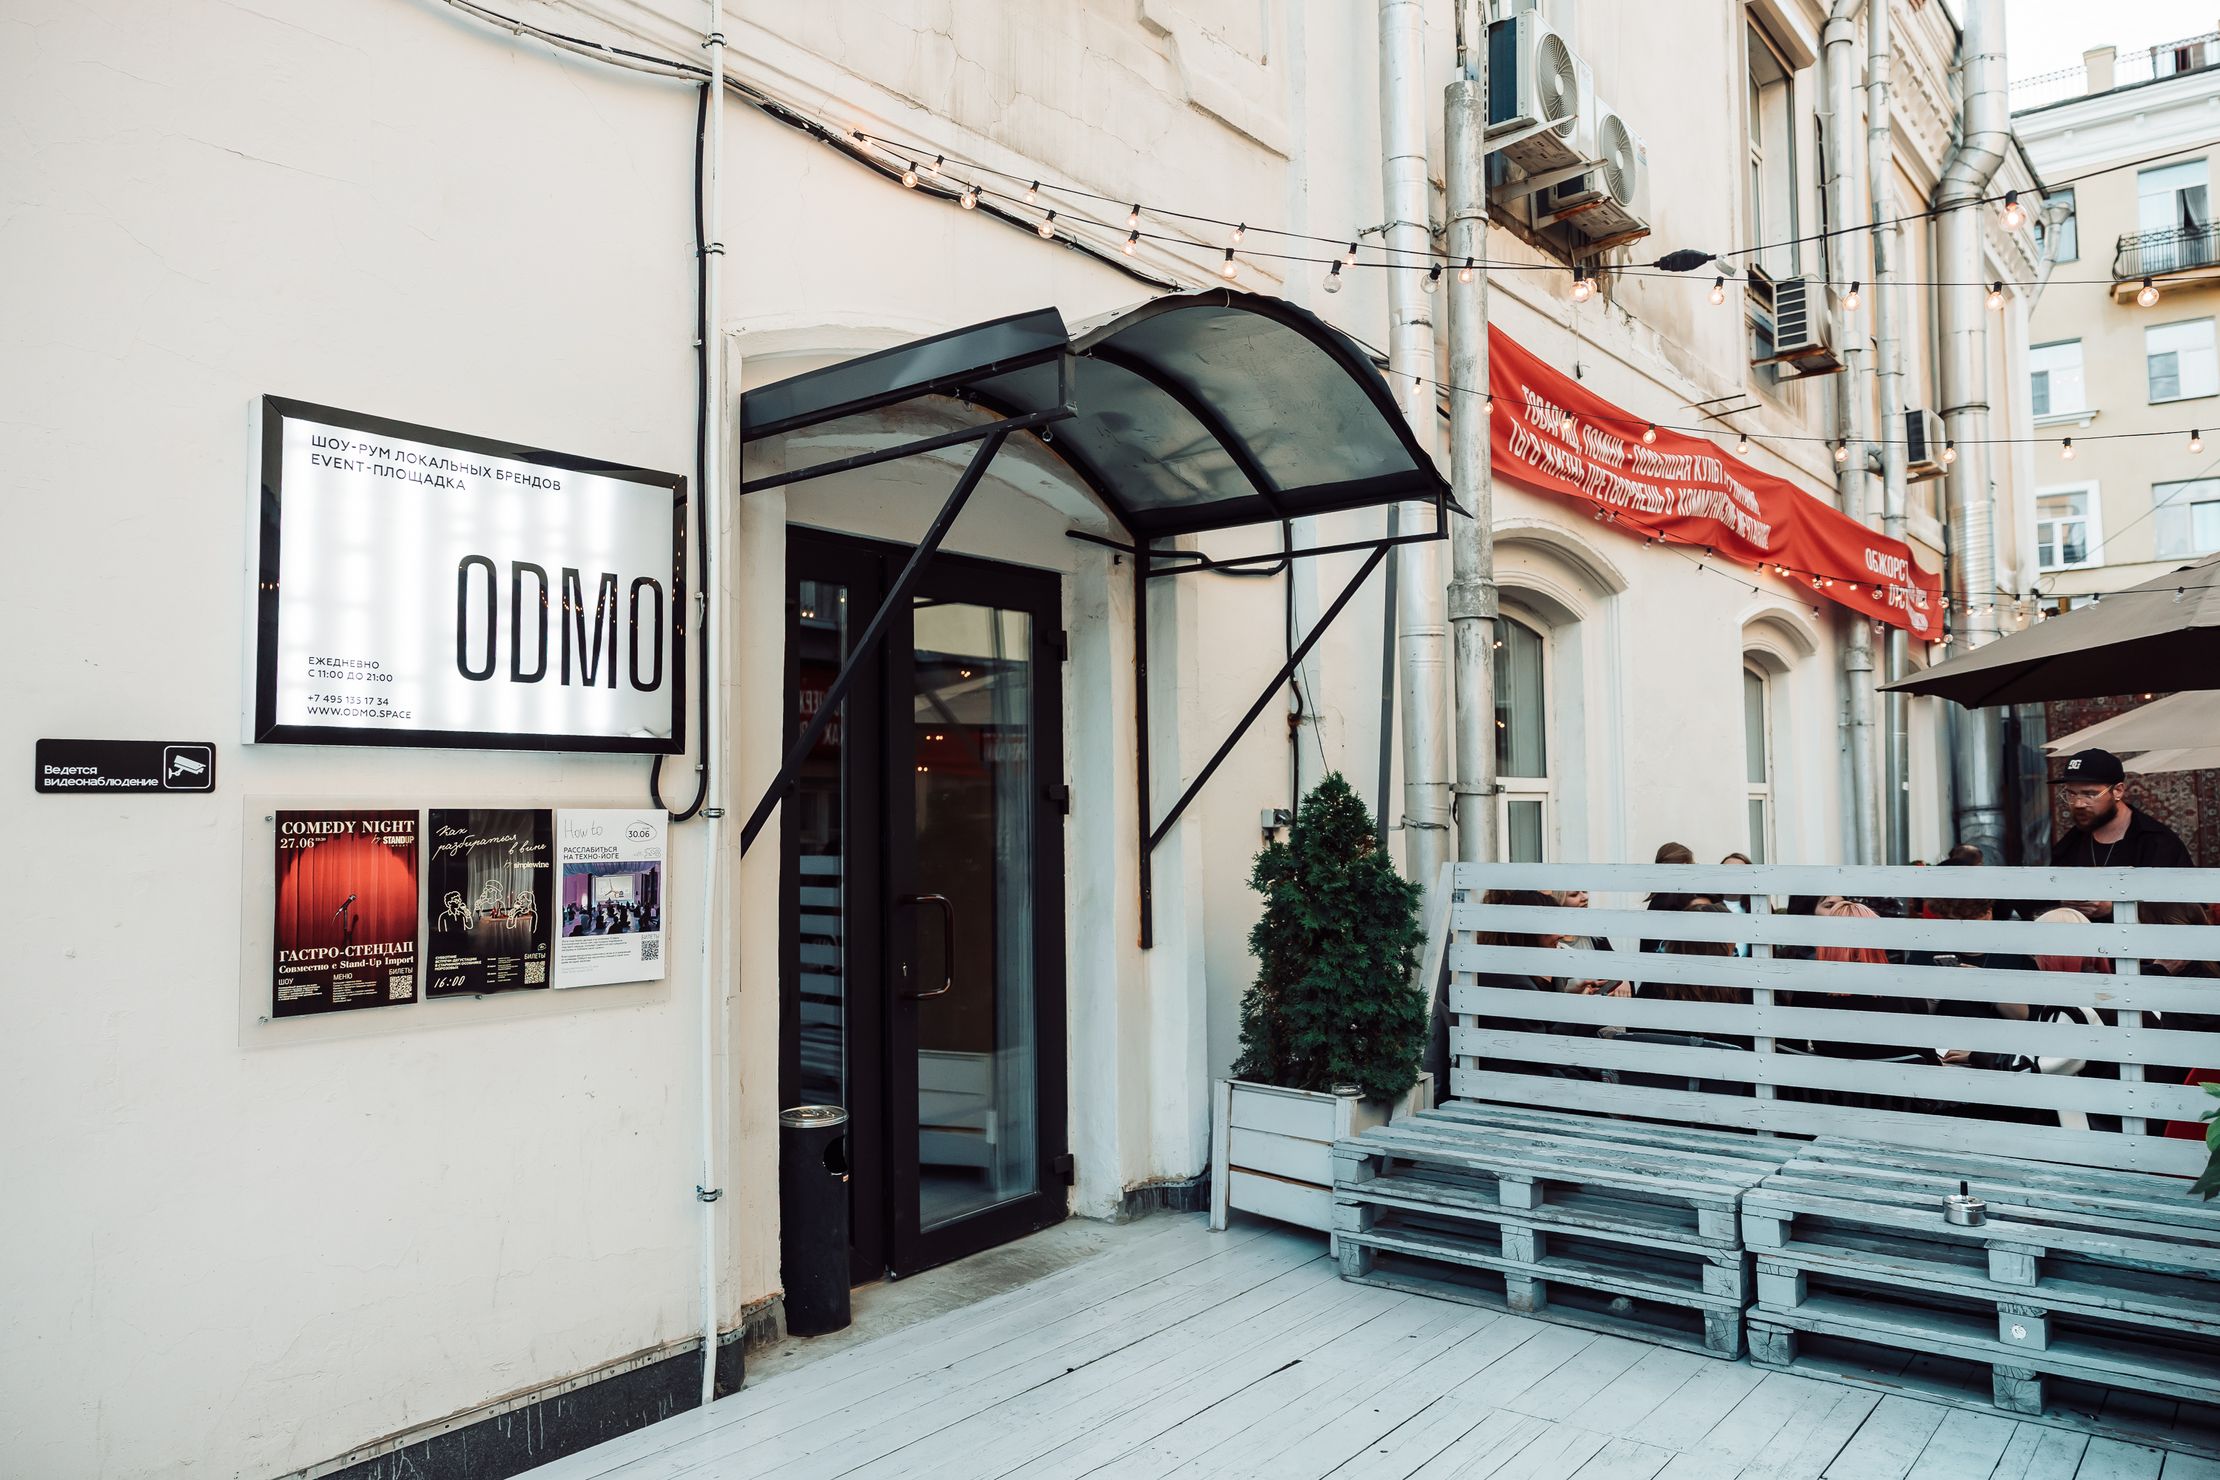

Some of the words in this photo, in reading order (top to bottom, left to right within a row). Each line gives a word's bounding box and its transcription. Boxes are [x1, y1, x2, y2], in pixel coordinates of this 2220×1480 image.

[1582, 424, 1625, 469] ПОМНИ
[1632, 444, 1693, 481] ПОВЫШАЯ
[311, 434, 391, 459] ШОУ-РУМ
[394, 450, 492, 479] ЛОКАЛЬНЫХ
[495, 468, 562, 492] БРЕНДОВ
[1508, 415, 1531, 461] ТЫ
[1528, 431, 1542, 466] В
[1539, 438, 1585, 488] ЖИЗНЬ
[1582, 462, 1665, 514] ПРЕТВОРЯЕШЬ
[1664, 486, 1675, 515] О
[311, 453, 466, 491] EVENT-ПЛОЩАДКА
[456, 554, 664, 692] ODMO
[308, 656, 380, 670] ЕЖЕДНЕВНО
[307, 669, 315, 678] С
[317, 669, 344, 679] 11:00
[346, 671, 364, 681] ДО
[366, 673, 393, 682] 21:00
[307, 694, 320, 703] +7
[322, 694, 343, 704] 495
[345, 696, 362, 705] 135
[364, 697, 374, 705] 17
[376, 697, 389, 706] 34
[307, 706, 412, 719] WWW.ODMO.SPACE
[44, 765, 98, 775] Ведется
[44, 776, 159, 787] видеонаблюдение
[281, 820, 357, 835] COMEDY
[361, 820, 415, 834] NIGHT
[436, 825, 468, 837] Как
[564, 819, 588, 839] How
[591, 819, 604, 836] to
[628, 830, 650, 838] 30.06
[280, 838, 315, 849] 27.06
[431, 834, 517, 861] разбираться
[508, 841, 519, 855] в
[519, 840, 547, 854] вине
[575, 852, 620, 860] ТЕХНО-ЙОГЕ
[279, 941, 414, 962] ГАСТРО-СТЕНДАП
[279, 963, 329, 974] Совместно
[339, 958, 382, 969] Stand-Up
[384, 956, 414, 966] Import
[388, 967, 414, 976] БИЛЕТЫ
[278, 977, 294, 986] ШОУ
[333, 973, 353, 981] МЕНЮ
[433, 975, 466, 989] 16:00
